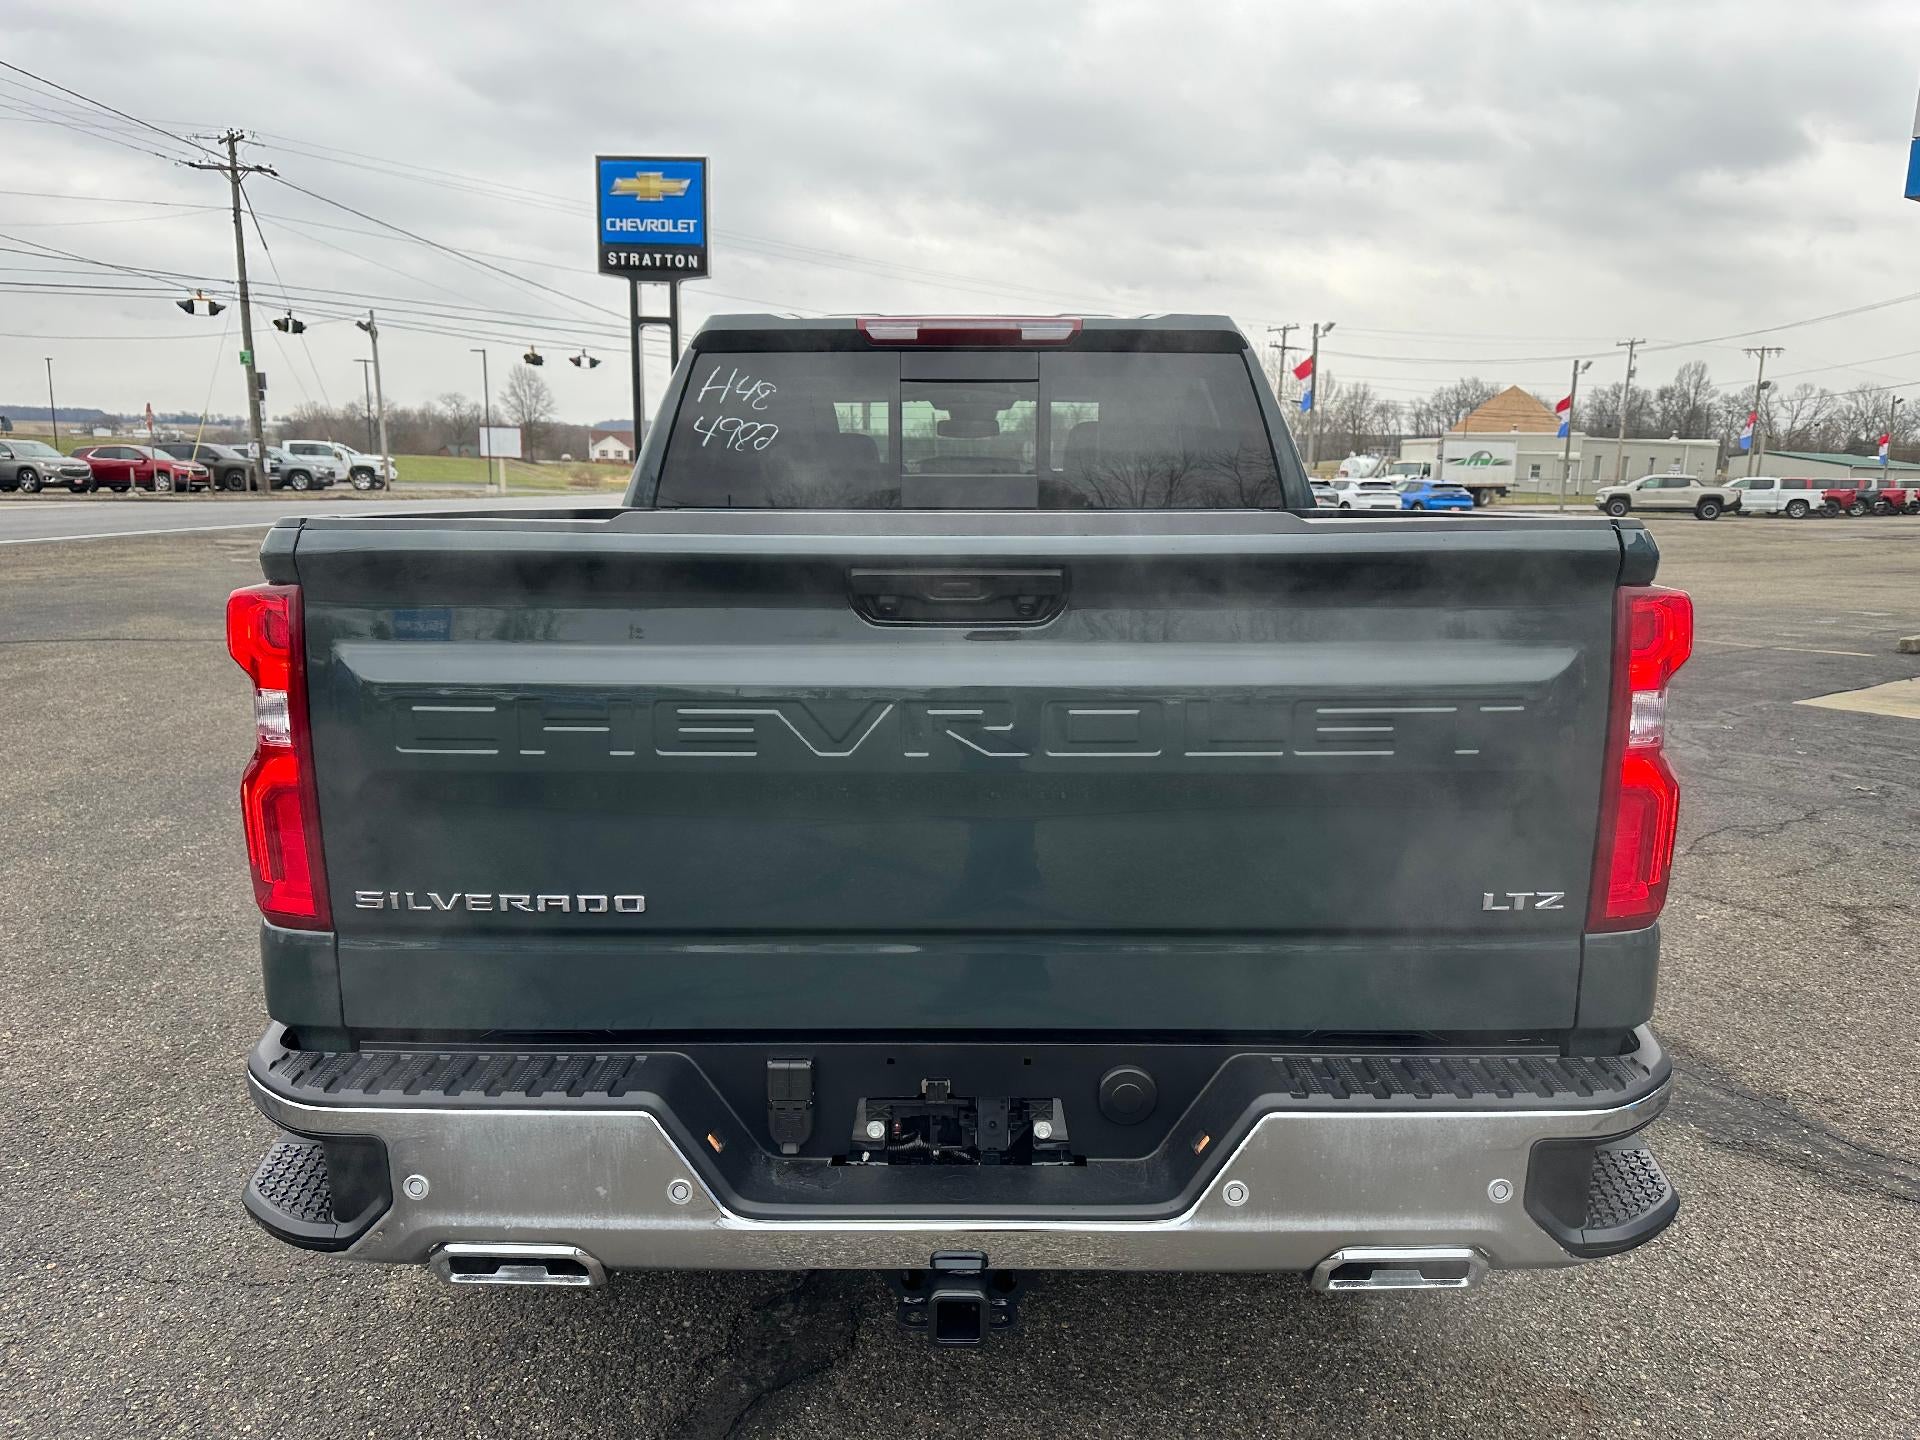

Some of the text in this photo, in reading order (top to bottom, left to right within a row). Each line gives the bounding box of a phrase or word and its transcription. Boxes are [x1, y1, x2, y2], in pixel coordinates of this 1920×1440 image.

[605, 218, 698, 233] CHEVROLET
[607, 251, 698, 268] STRATTON
[394, 699, 1528, 758] CHEVROLET
[355, 890, 646, 913] SILVERADO
[1482, 891, 1565, 911] LTZ
